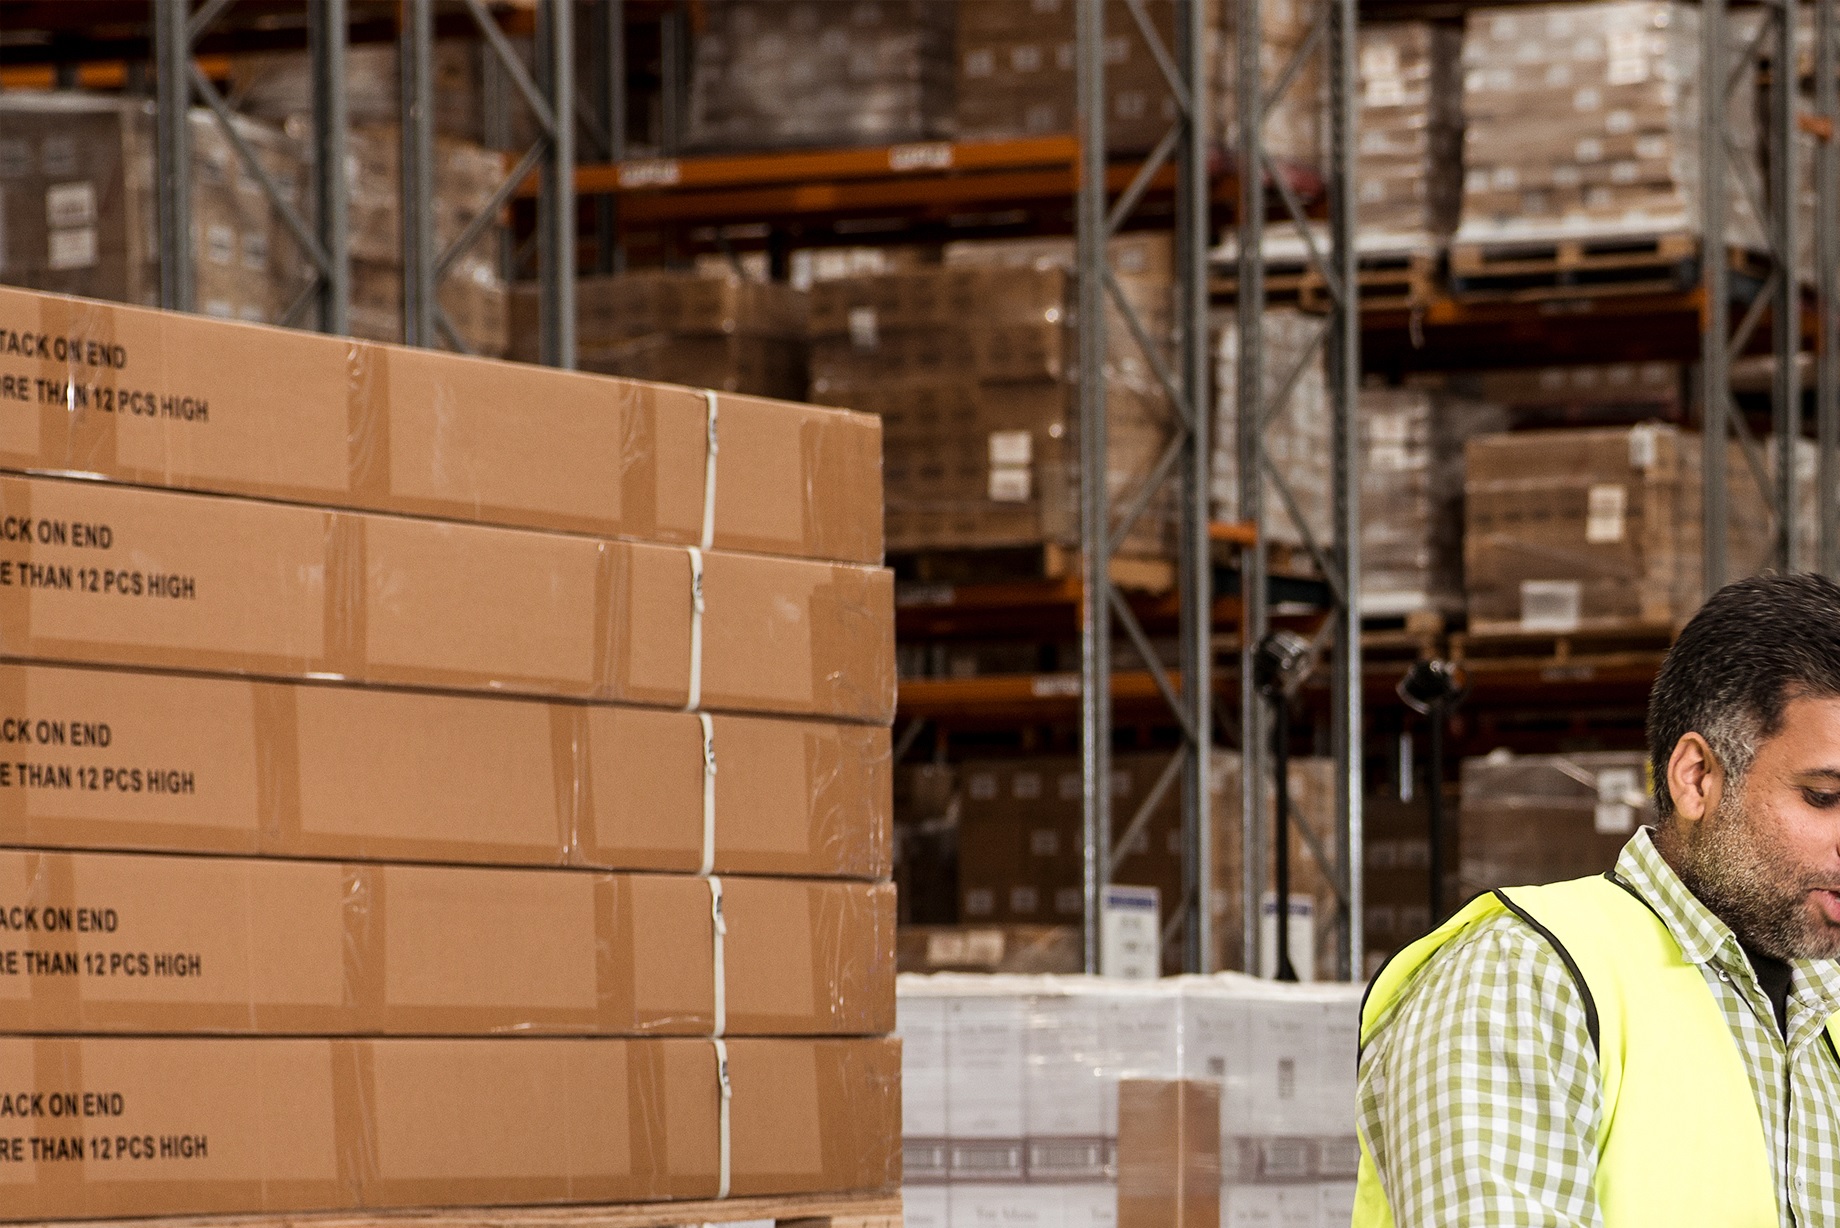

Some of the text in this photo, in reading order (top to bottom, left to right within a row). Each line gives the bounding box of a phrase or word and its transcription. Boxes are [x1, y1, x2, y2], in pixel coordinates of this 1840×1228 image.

[54, 335, 81, 362] ON
[86, 339, 127, 369] END
[94, 386, 113, 412] 12
[118, 389, 157, 417] PCS
[161, 395, 209, 423] HIGH
[37, 518, 67, 545] ON
[72, 522, 113, 549] END
[17, 563, 72, 589] THAN
[78, 568, 99, 593] 12
[104, 569, 143, 596] PCS
[147, 571, 196, 600] HIGH
[0, 718, 112, 747] CK ON END
[16, 763, 71, 789] THAN
[77, 767, 98, 790] 12
[103, 766, 142, 792] PCS
[147, 769, 195, 794] HIGH
[43, 907, 71, 932] ON
[77, 908, 118, 932] END
[24, 951, 78, 976] THAN
[84, 952, 105, 976] 12
[110, 953, 149, 976] PCS
[154, 953, 201, 977] HIGH
[50, 1092, 77, 1117] ON
[83, 1092, 124, 1117] END
[29, 1137, 84, 1161] THAN
[90, 1137, 110, 1160] 12
[116, 1135, 155, 1160] PCS
[160, 1134, 207, 1159] HIGH
